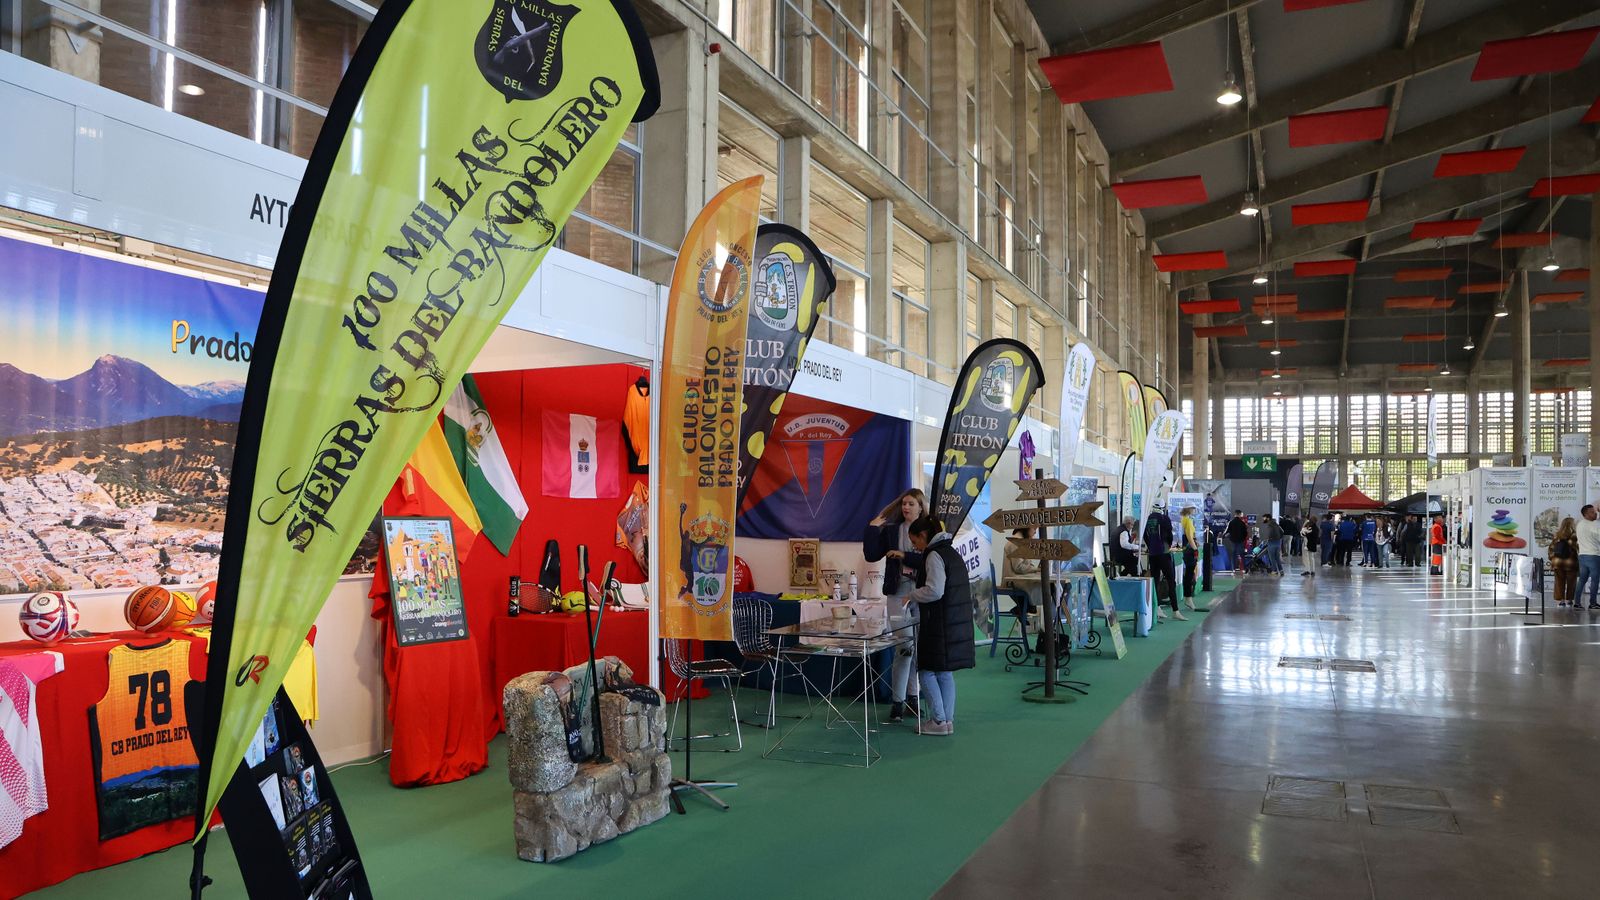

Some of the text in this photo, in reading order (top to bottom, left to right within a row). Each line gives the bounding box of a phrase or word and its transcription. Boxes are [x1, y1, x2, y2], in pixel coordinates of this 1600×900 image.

[488, 8, 505, 52] SIERRAS
[503, 76, 523, 91] DEL
[342, 125, 509, 351] 100 MILLAS
[275, 76, 622, 553] SIERRAS DEL BANDOLERO
[172, 319, 253, 363] Prado
[746, 339, 785, 359] LUB
[744, 363, 795, 386] ITÓN
[804, 360, 822, 377] PRADO
[822, 364, 832, 380] DEL
[833, 367, 843, 382] REY
[683, 378, 701, 454] CLUB DE
[698, 347, 721, 488] BALONCESTO
[718, 347, 740, 488] PRADO DEL REY
[806, 417, 846, 431] JUVENTUD
[961, 415, 998, 430] CLUB
[953, 432, 1003, 449] TRITÓN
[948, 506, 962, 514] REY
[1489, 496, 1526, 505] Cofenat
[969, 537, 979, 553] DE
[128, 669, 172, 731] 78
[111, 726, 189, 756] CB PRADO DEL REY
